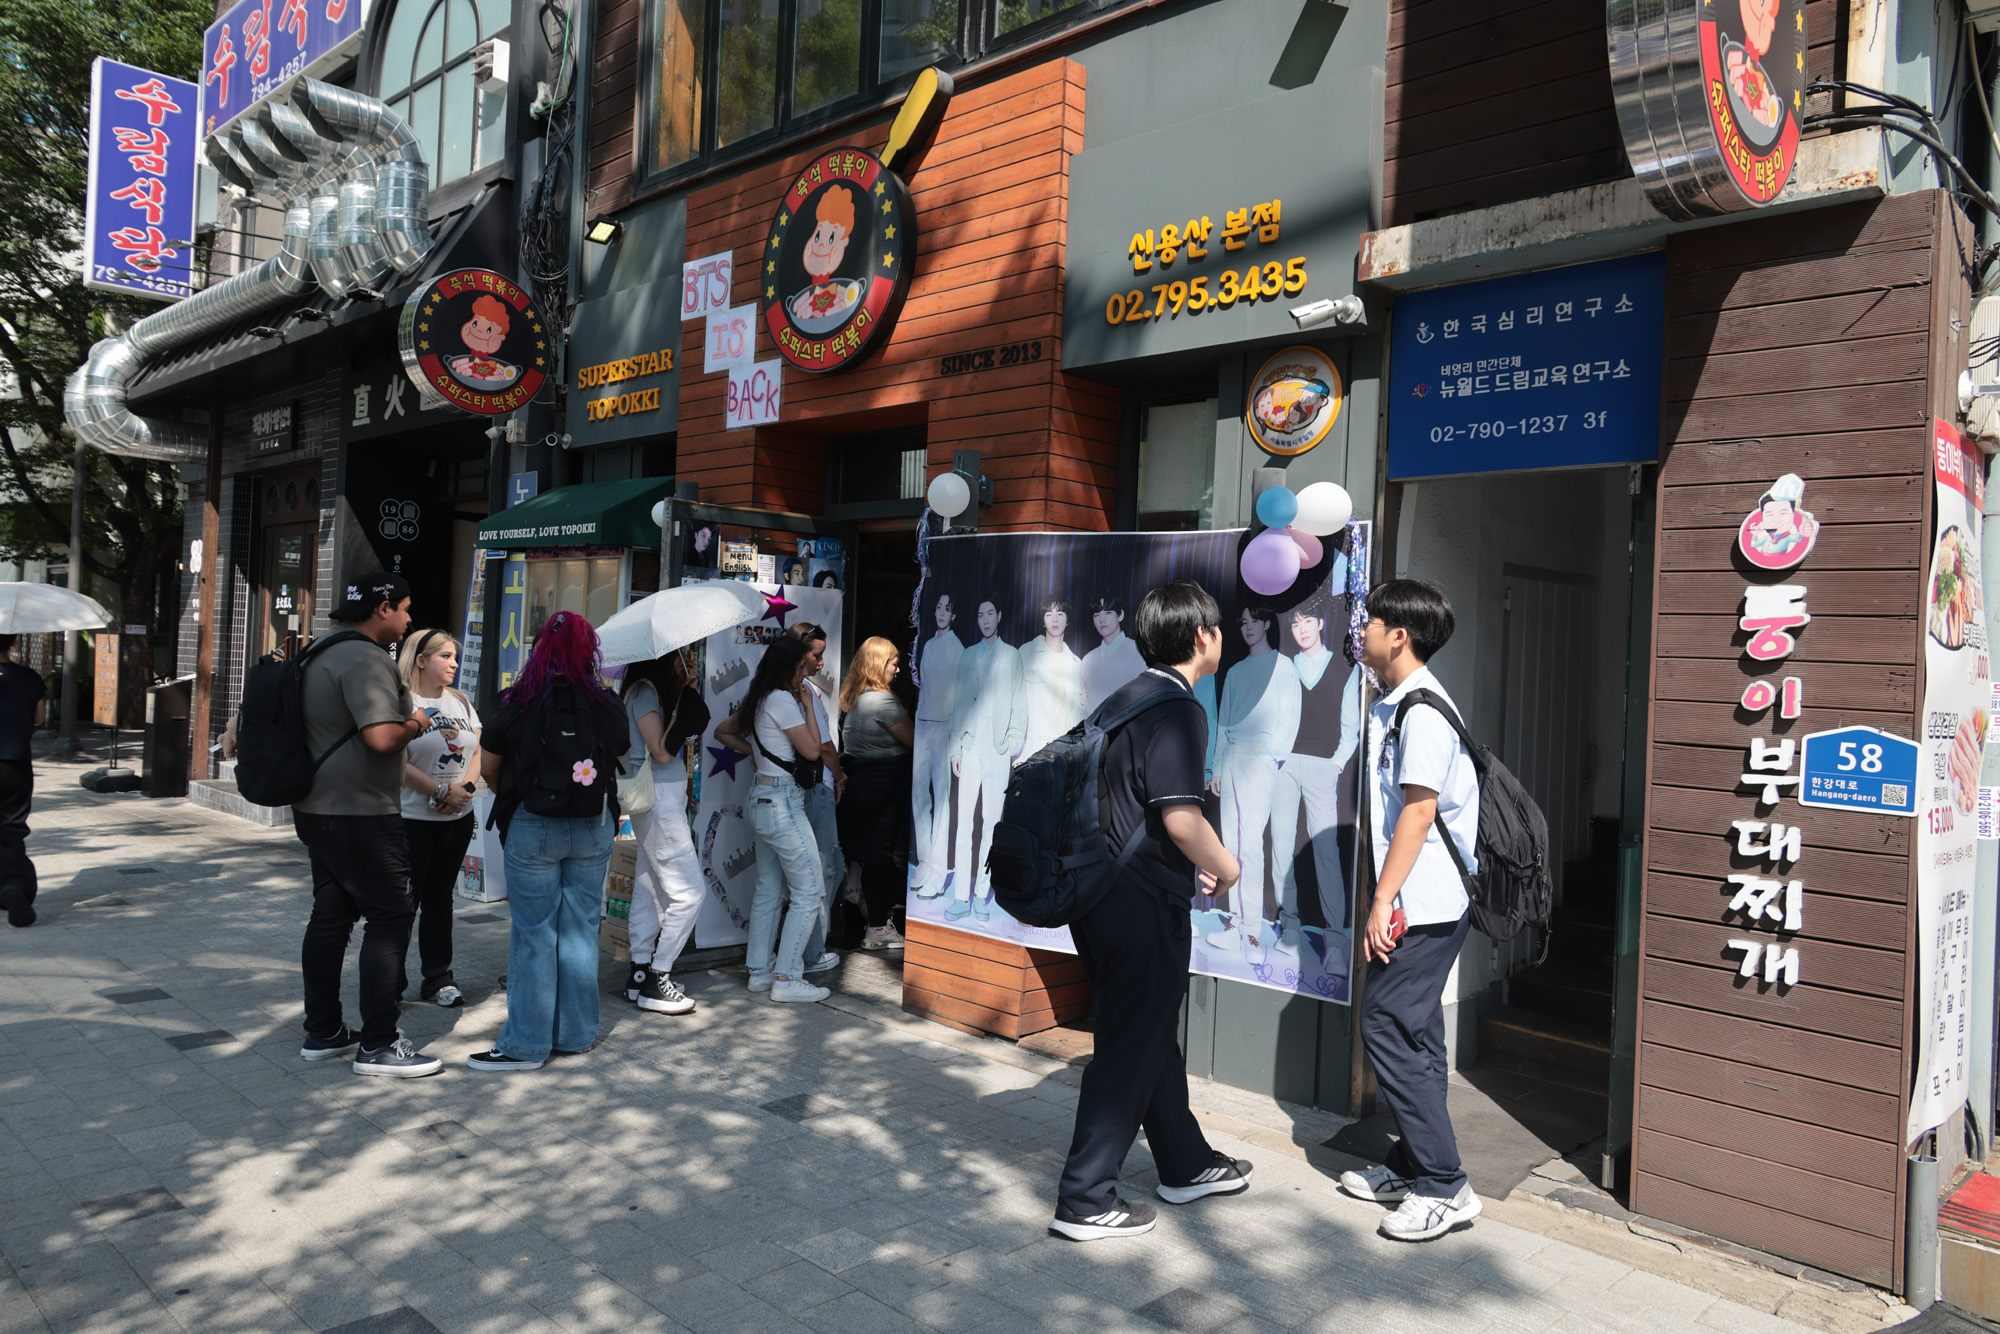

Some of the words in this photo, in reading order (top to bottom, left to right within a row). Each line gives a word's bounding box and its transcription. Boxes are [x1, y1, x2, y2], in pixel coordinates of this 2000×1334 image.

[251, 52, 307, 102] 794-4257
[1711, 78, 1751, 184] 슈퍼스타
[1755, 144, 1785, 200] 떡볶이
[796, 163, 822, 197] 즉석
[828, 152, 869, 178] 떡볶이
[1128, 215, 1213, 271] 신용산
[1221, 199, 1282, 251] 본점
[449, 272, 476, 291] 즉석
[482, 274, 520, 301] 떡볶이
[683, 259, 731, 313] BTS
[1105, 256, 1308, 325] 02.795.3435
[711, 318, 748, 360] IS
[779, 326, 826, 362] 슈퍼스타
[831, 307, 874, 358] 떡볶이
[577, 348, 674, 390] SUPERSTAR
[940, 348, 996, 376] SINCE
[999, 340, 1042, 366] 2013
[1440, 361, 1473, 376] 비영리
[1476, 355, 1522, 373] 민간단체
[436, 375, 486, 409] 슈퍼스타
[492, 384, 528, 412] 떡볶이
[727, 368, 779, 421] BACK
[1439, 375, 1491, 399] 뉴월드
[1494, 365, 1568, 393] 드림교육
[1572, 358, 1632, 384] 연구소
[587, 387, 662, 422] TOPOKKI
[1430, 414, 1569, 443] 02-790-1237
[1583, 411, 1607, 430] 3f
[384, 505, 397, 514] 19
[402, 525, 415, 534] 86
[479, 530, 498, 541] LOVE
[499, 528, 537, 540] YOURSELF,
[539, 526, 560, 537] LOVE
[561, 522, 596, 536] TOPOKKI
[724, 563, 752, 572] English
[730, 552, 753, 561] Menu
[1837, 741, 1883, 773] 58
[1811, 776, 1859, 790] 한강대로
[1811, 788, 1877, 803] Hangang-daero
[1978, 788, 1992, 838] 010-2106-5667
